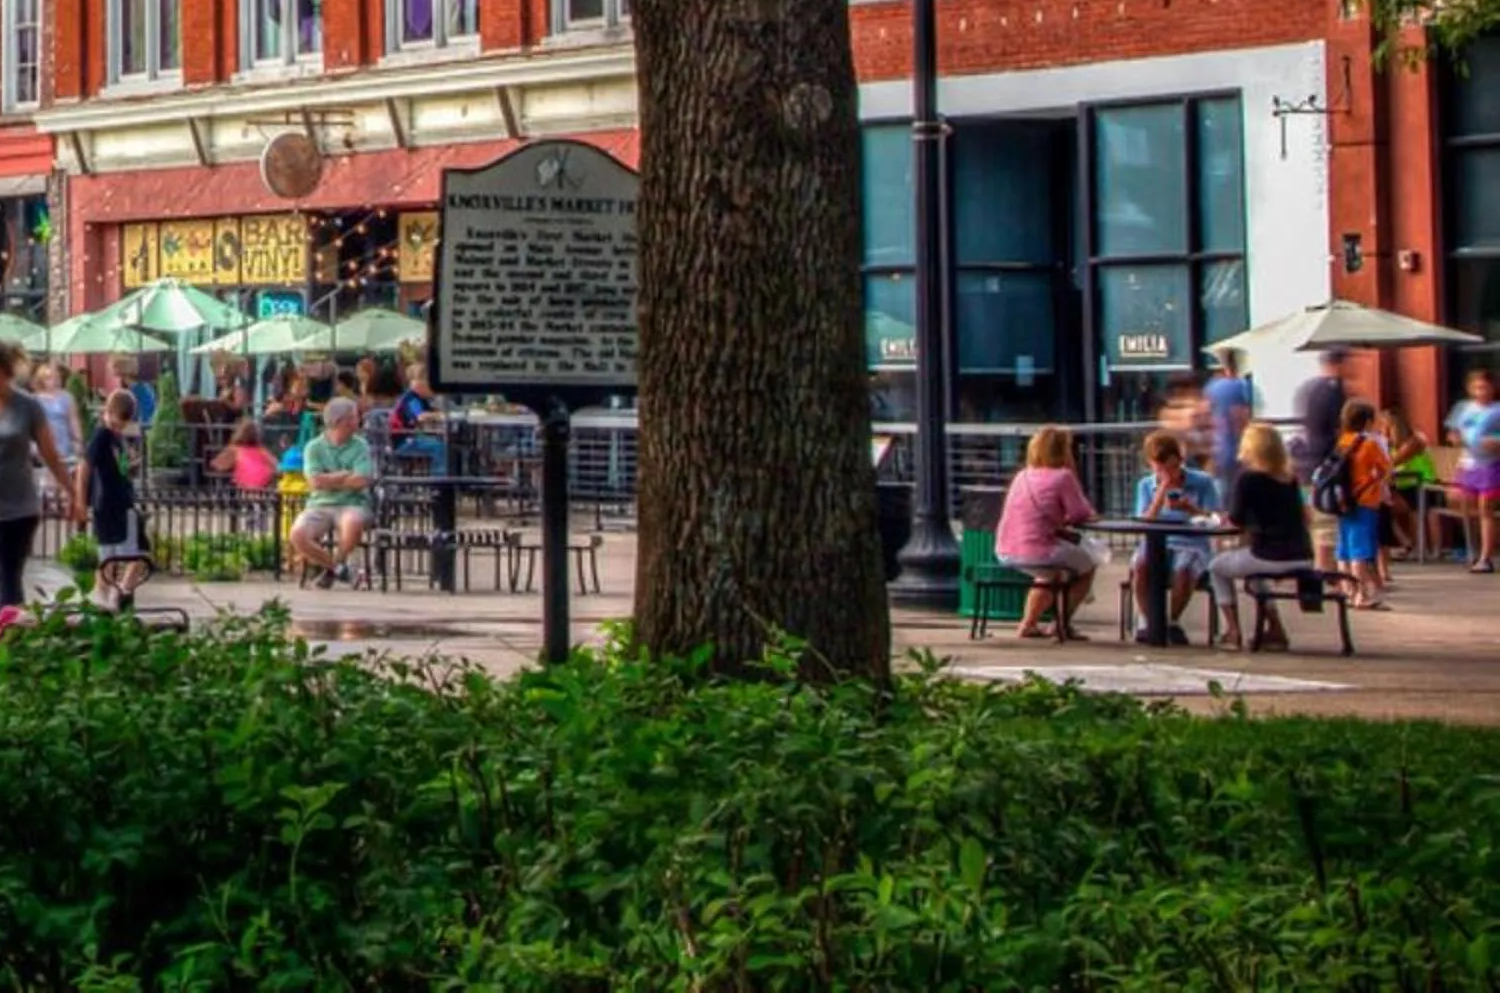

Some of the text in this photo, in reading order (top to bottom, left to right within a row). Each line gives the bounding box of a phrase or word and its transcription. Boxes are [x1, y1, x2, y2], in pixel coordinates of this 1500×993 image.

[448, 194, 546, 210] KNOXVILLE'S
[551, 197, 614, 213] MARKET
[245, 218, 305, 246] BAR
